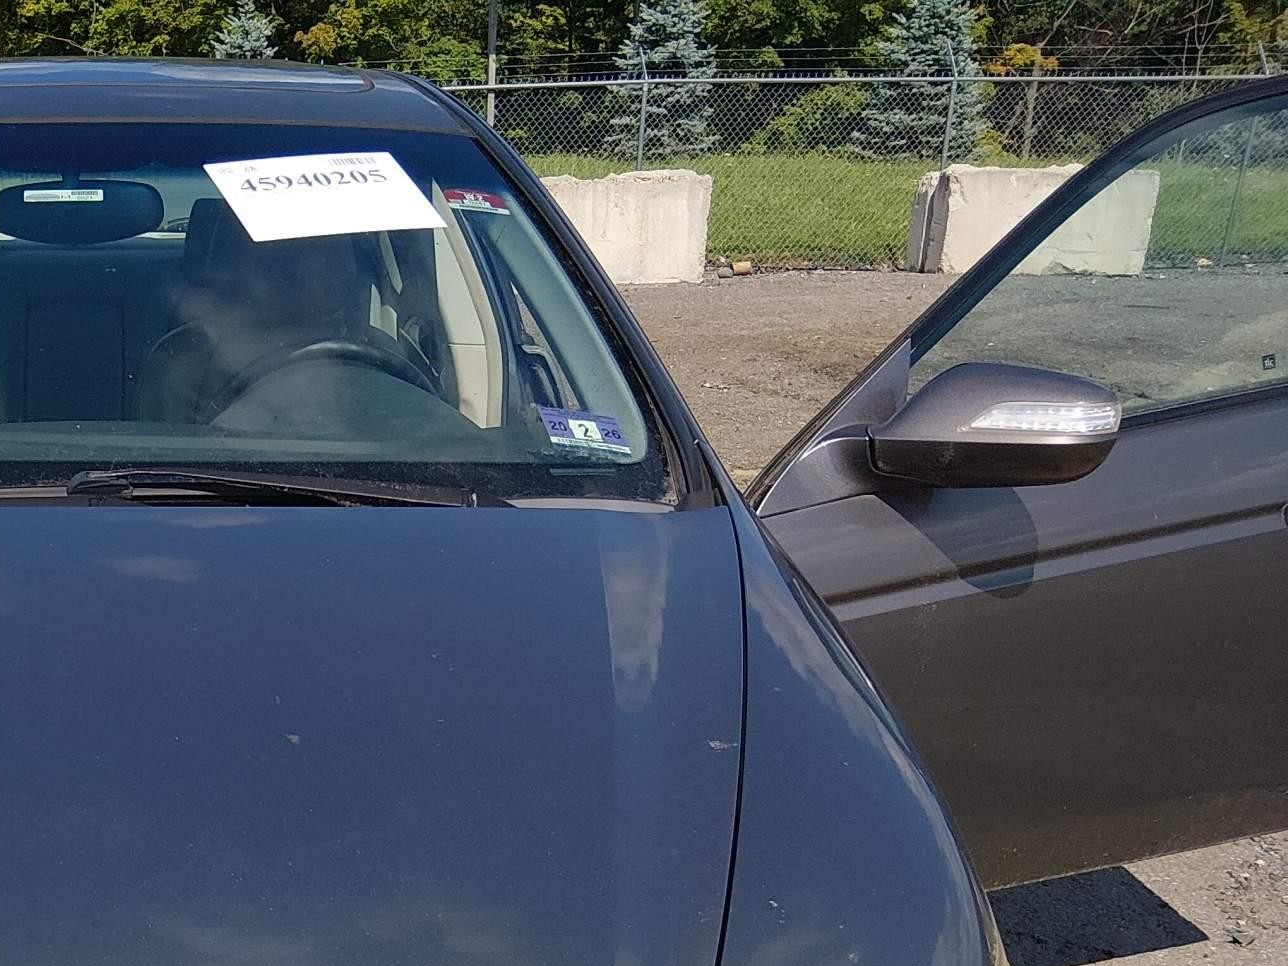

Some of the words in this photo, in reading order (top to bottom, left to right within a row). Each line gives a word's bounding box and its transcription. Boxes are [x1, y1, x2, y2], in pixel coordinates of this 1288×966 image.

[240, 169, 388, 193] 45940205
[549, 420, 568, 432] 20
[578, 423, 593, 438] 2
[602, 428, 622, 440] 26
